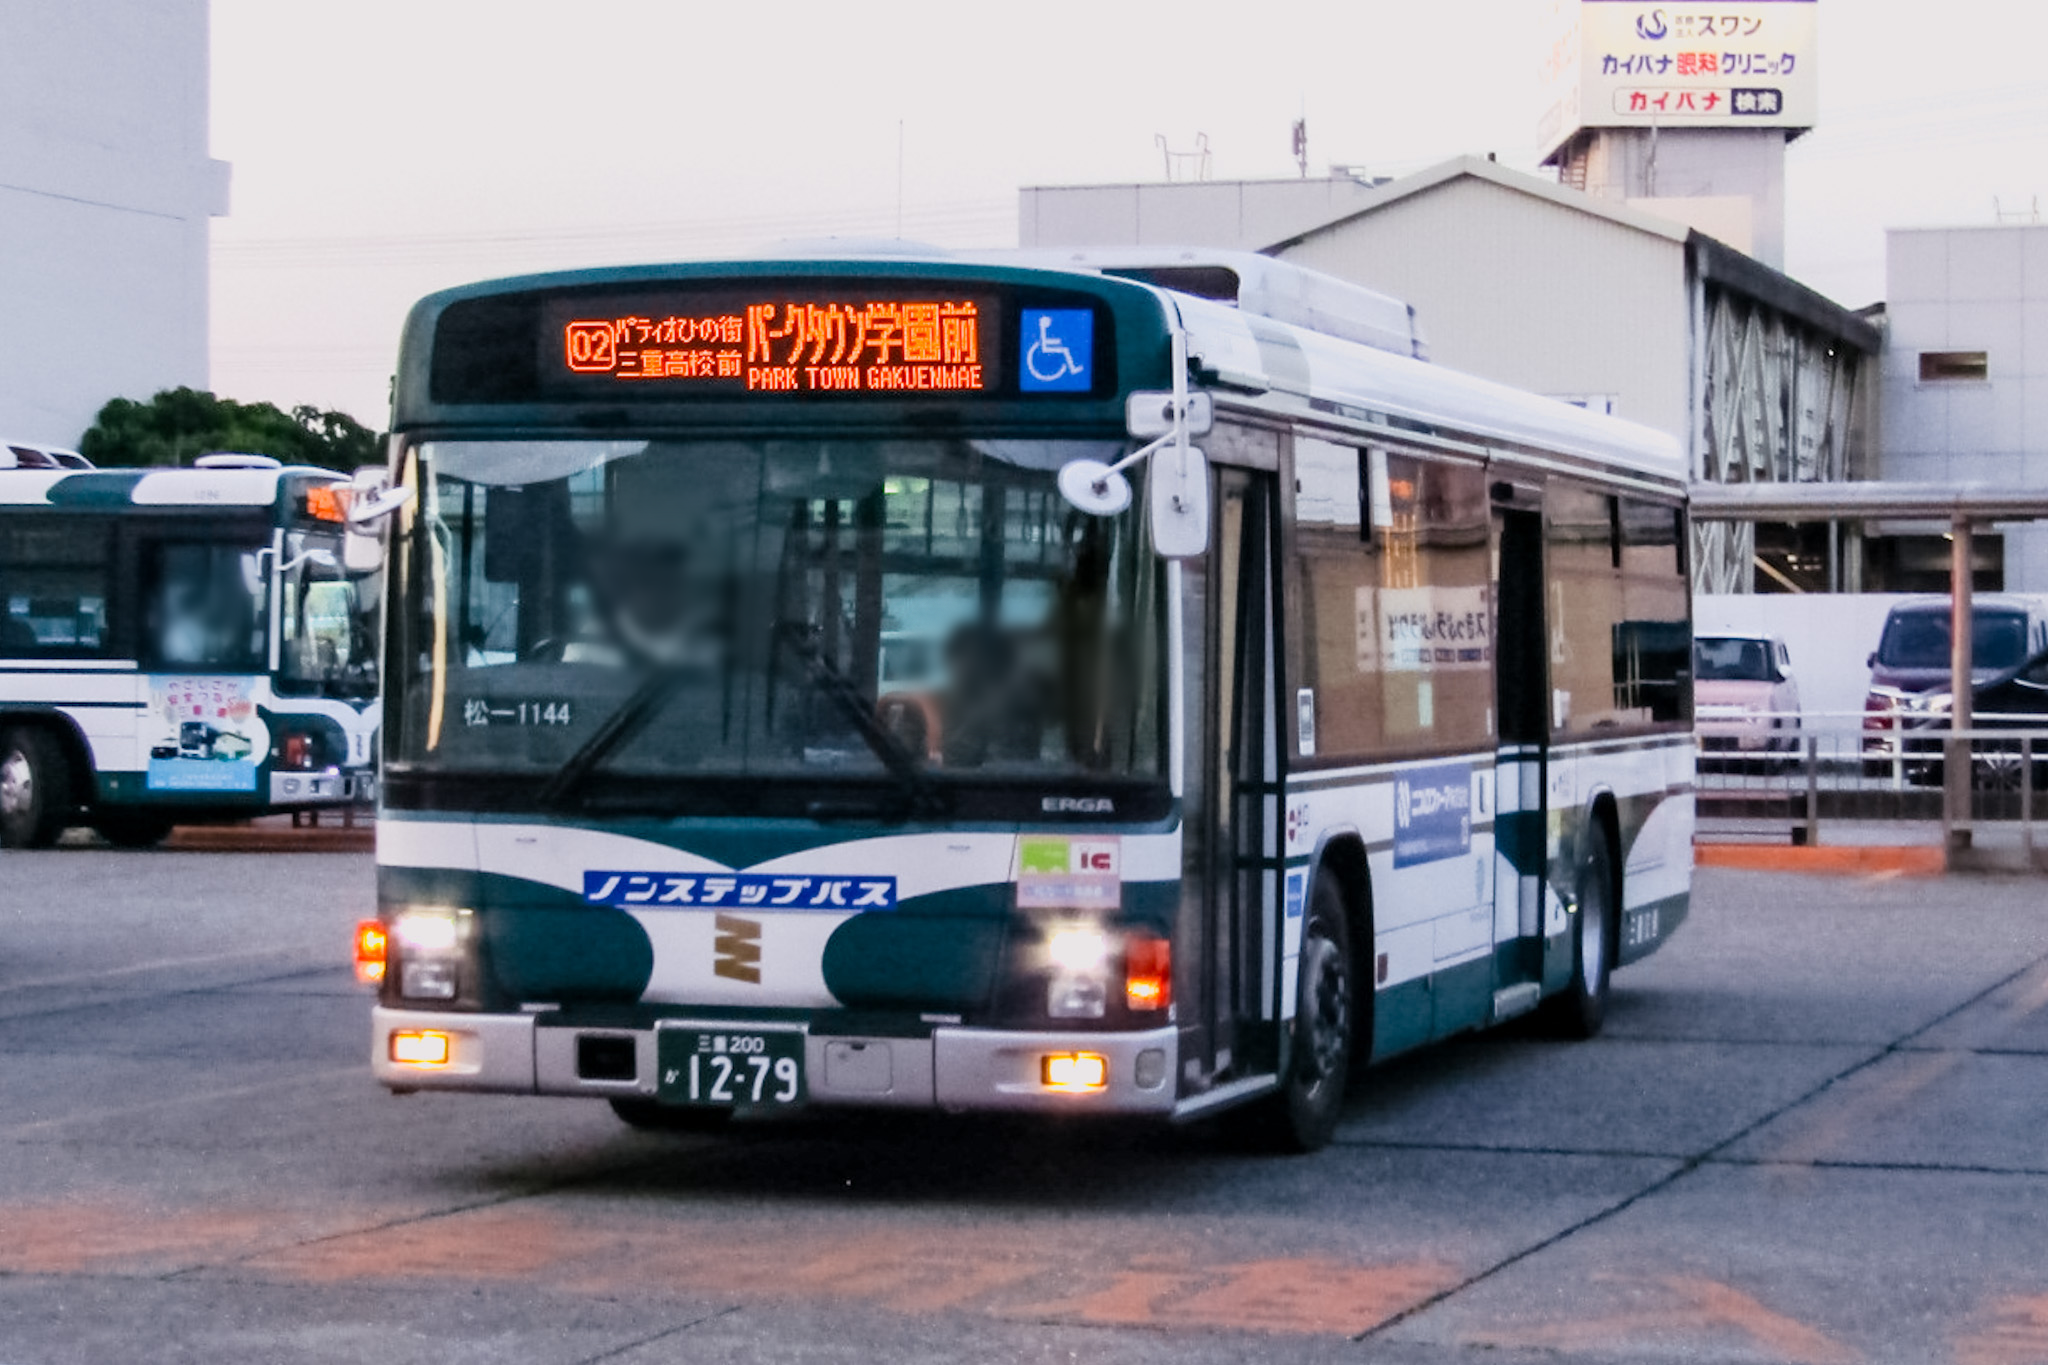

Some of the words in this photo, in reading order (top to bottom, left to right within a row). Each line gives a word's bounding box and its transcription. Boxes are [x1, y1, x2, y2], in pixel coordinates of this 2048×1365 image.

[1698, 15, 1762, 37] スワン
[1629, 91, 1722, 111] カイバナ
[614, 315, 744, 344] パティオひの街
[746, 301, 978, 364] パークタウン学園前
[571, 329, 612, 362] 02
[615, 349, 744, 378] 三重高校前
[747, 365, 799, 390] PARK
[804, 366, 861, 390] TOWN
[866, 365, 984, 390] GAKUENMAE
[1041, 796, 1115, 813] ERGA
[588, 875, 892, 906] ノンステップバス
